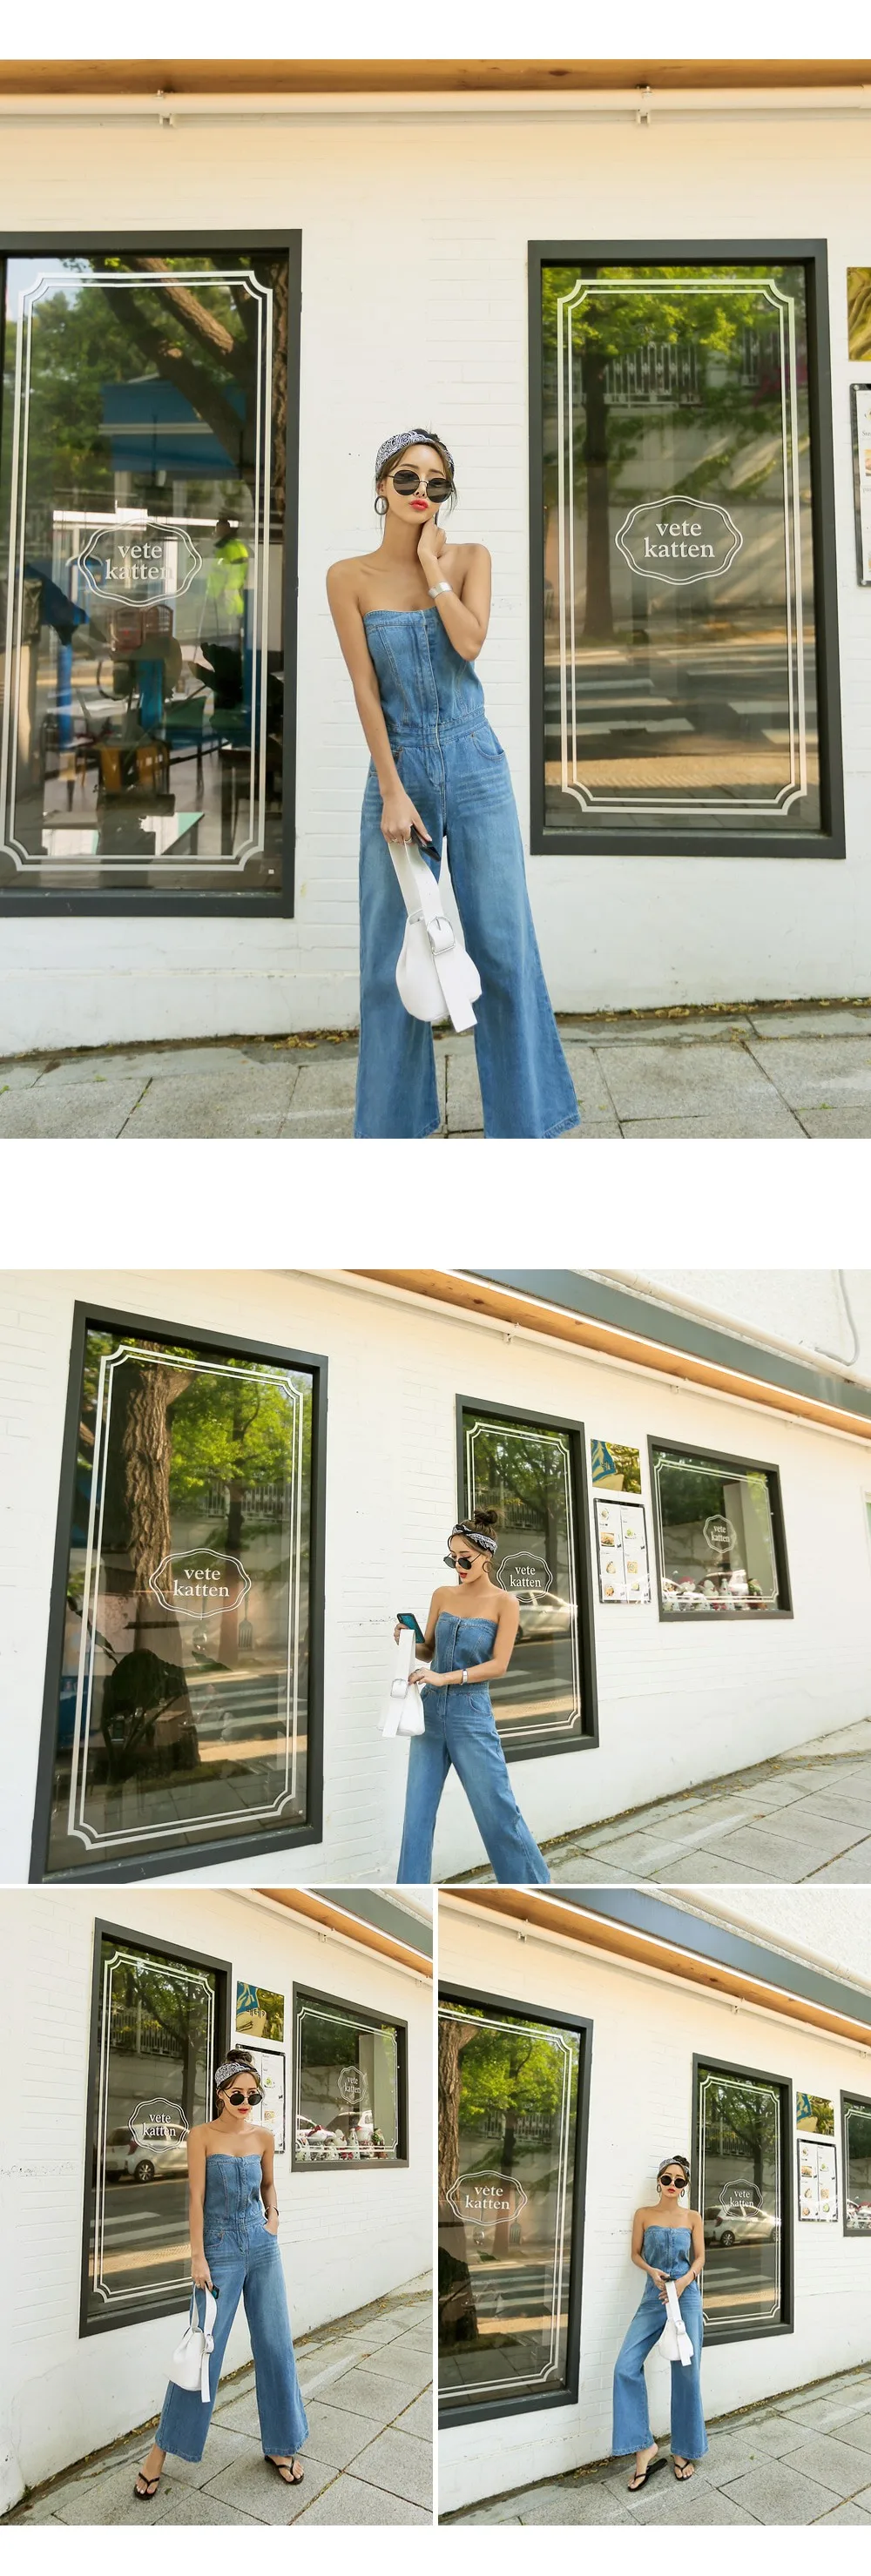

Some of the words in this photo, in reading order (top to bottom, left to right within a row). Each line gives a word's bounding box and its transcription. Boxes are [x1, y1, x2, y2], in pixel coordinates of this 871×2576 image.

[656, 520, 702, 537] vete
[118, 542, 162, 559] vete
[644, 536, 715, 558] katten
[105, 558, 174, 580] katten
[184, 1567, 221, 1581] vete
[515, 1565, 536, 1576] vete
[173, 1579, 230, 1597] katten
[510, 1574, 542, 1588] katten
[149, 2113, 172, 2123] vete
[142, 2122, 177, 2137] katten
[474, 2185, 503, 2196] vete
[733, 2189, 751, 2198] vete
[465, 2195, 510, 2210] katten
[729, 2196, 754, 2208] katten
